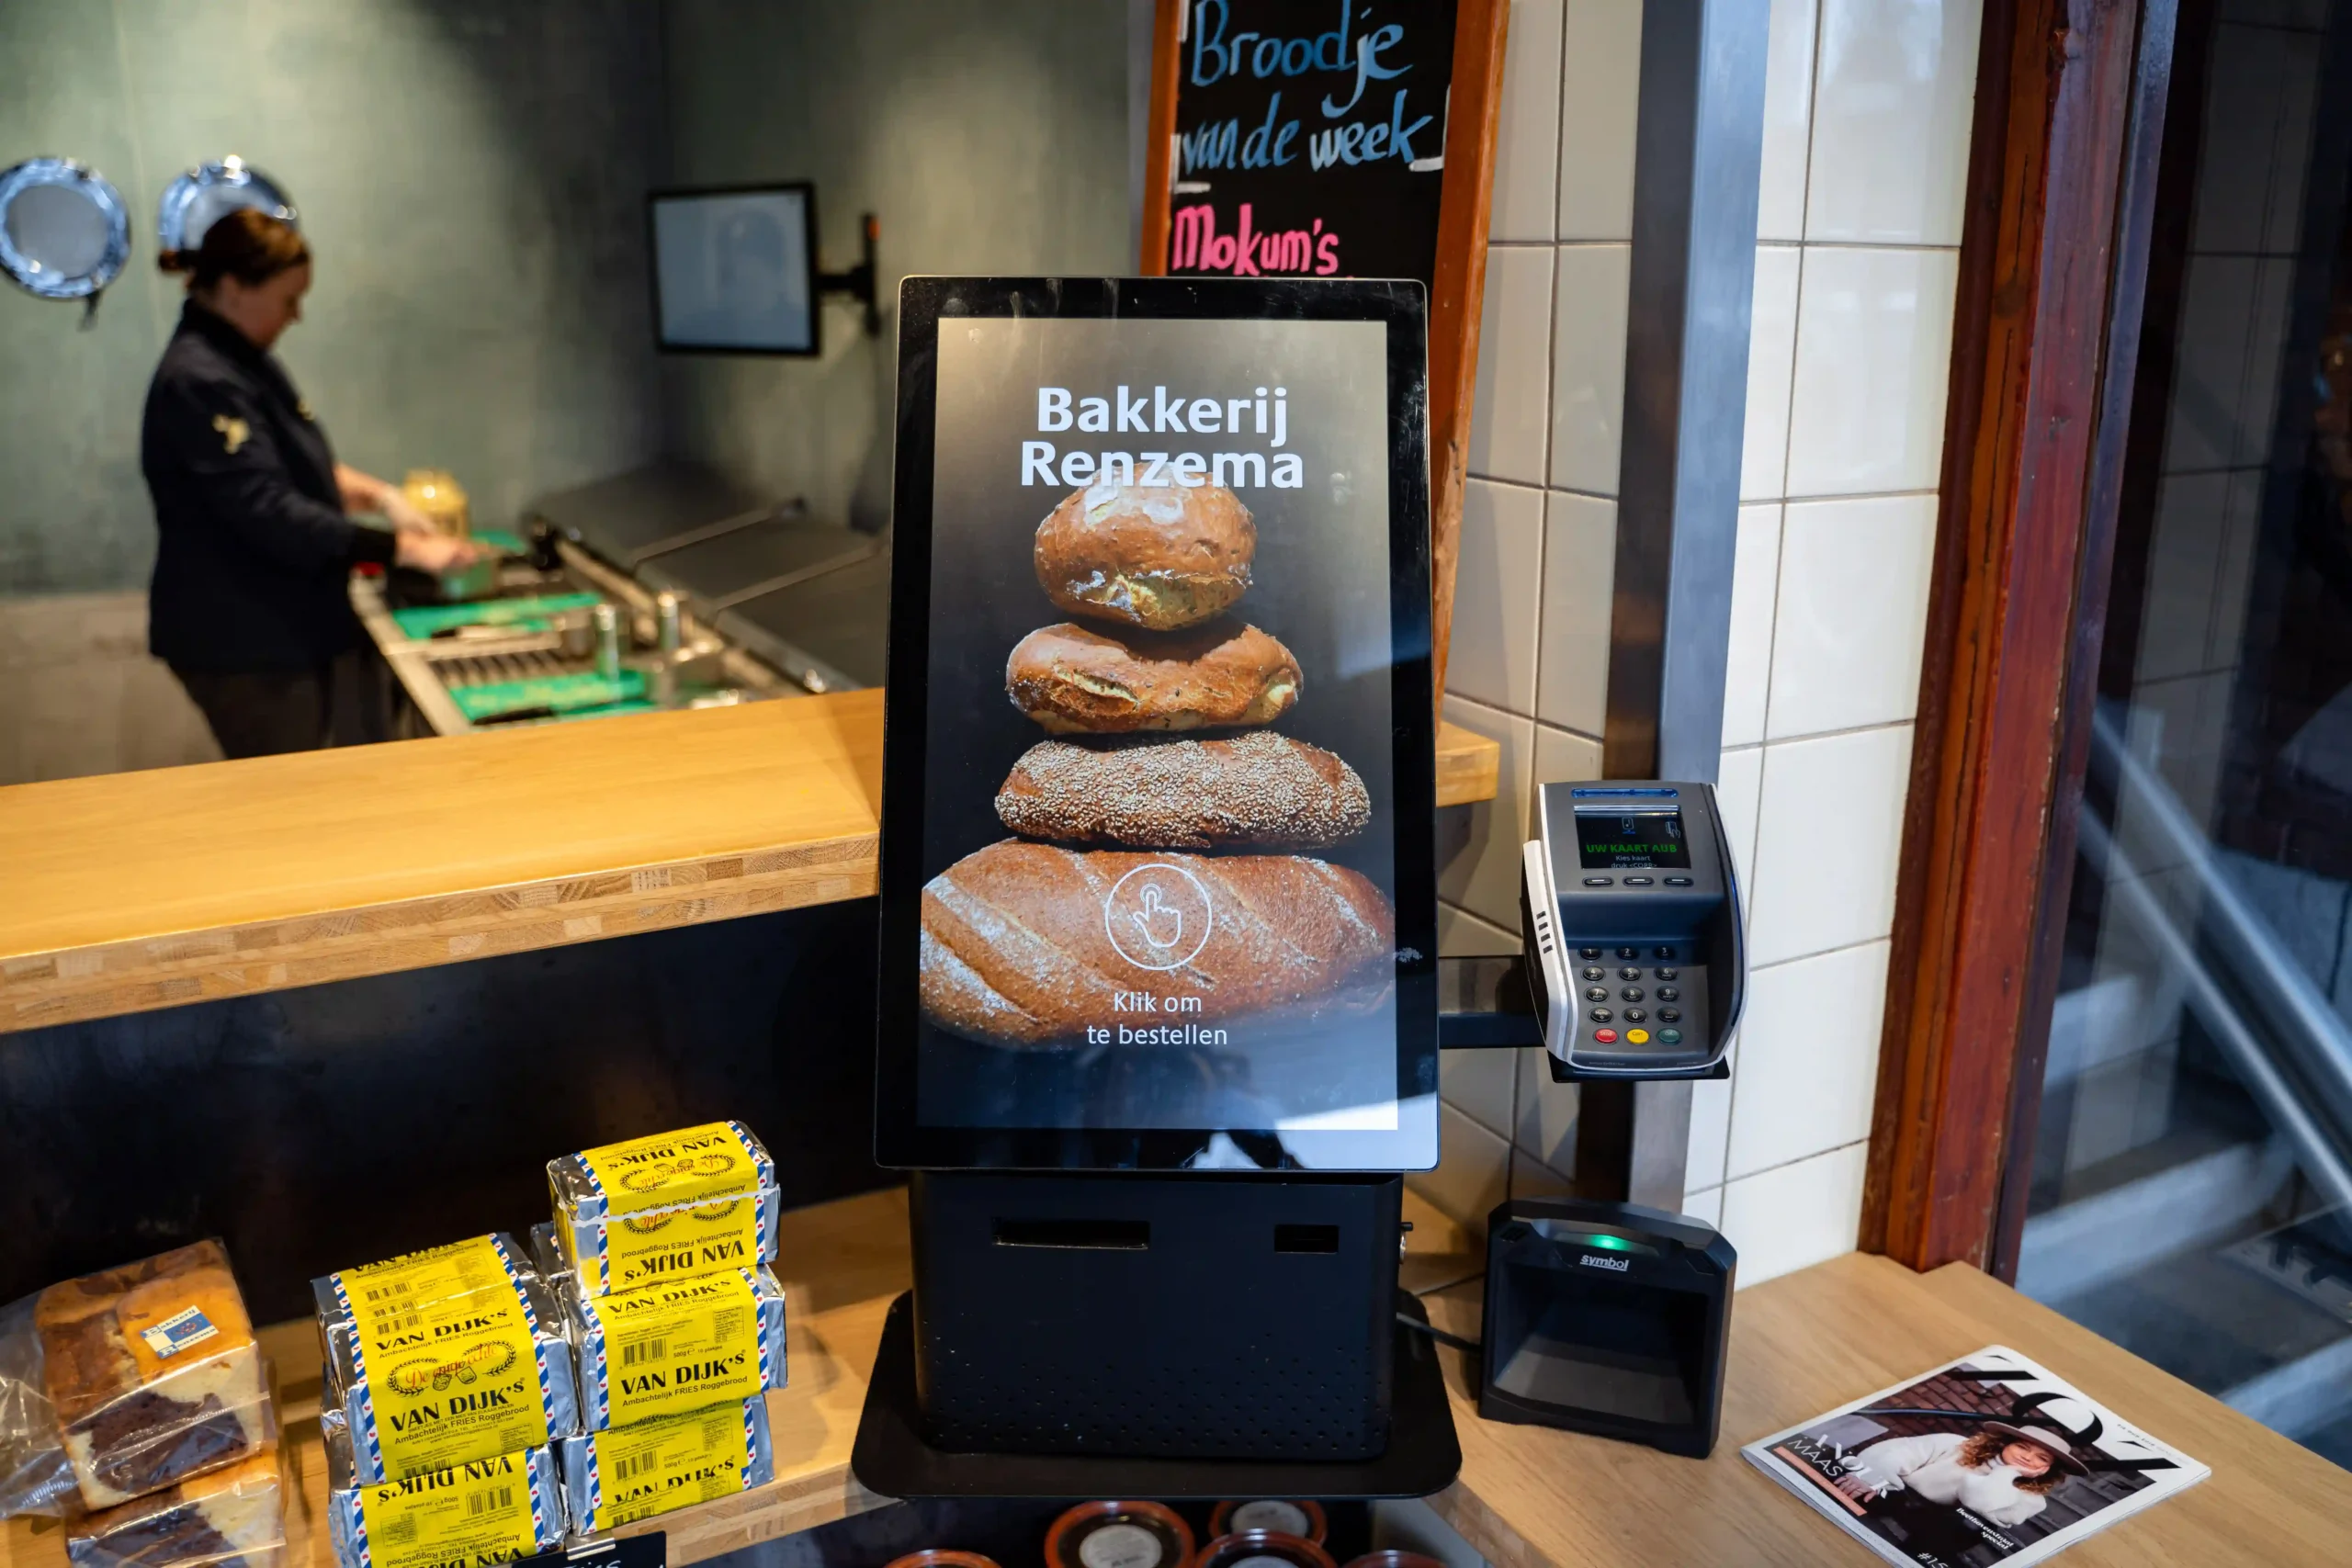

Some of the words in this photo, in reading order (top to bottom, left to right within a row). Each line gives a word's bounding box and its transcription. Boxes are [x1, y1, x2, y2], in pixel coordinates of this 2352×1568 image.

[1191, 0, 1413, 118] Broodje
[1309, 88, 1434, 173] week
[1171, 203, 1340, 276] Mokum's
[1037, 385, 1287, 447] Bakkerij
[1021, 441, 1304, 489] Renzema
[1586, 844, 1607, 852] UW
[1611, 844, 1648, 852] KAART
[1652, 844, 1678, 852] AUB
[1114, 991, 1157, 1012] Klik
[1164, 997, 1202, 1012] om
[1087, 1025, 1111, 1044] te
[1119, 1023, 1227, 1045] bestellen
[683, 1136, 727, 1153] VAN
[697, 1184, 746, 1201] Ambachtelijk
[672, 1239, 695, 1250] FRIES
[696, 1228, 743, 1245] Ambachtelijk
[621, 1244, 669, 1259] Roggebrood
[703, 1240, 745, 1264] VAN
[1580, 1254, 1629, 1269] symbol
[607, 1296, 655, 1314] VAN
[376, 1331, 424, 1351] VAN
[379, 1342, 433, 1359] Ambachtelijk
[435, 1334, 460, 1345] FRIES
[462, 1323, 514, 1338] Roggebrood
[621, 1371, 666, 1395] VAN
[622, 1391, 673, 1407] Ambachtelijk
[674, 1384, 698, 1396] FRIES
[700, 1376, 748, 1391] Roggebrood
[390, 1402, 440, 1432] VAN
[394, 1422, 448, 1445] Ambachtelijk
[450, 1415, 477, 1427] FRIES
[478, 1404, 530, 1423] Roggebrood
[1788, 1439, 1843, 1476] MAAS
[465, 1456, 513, 1483] VAN
[441, 1545, 466, 1558] FRIES
[469, 1533, 520, 1552] Ambachtelijk
[386, 1550, 439, 1568] Roggebrood
